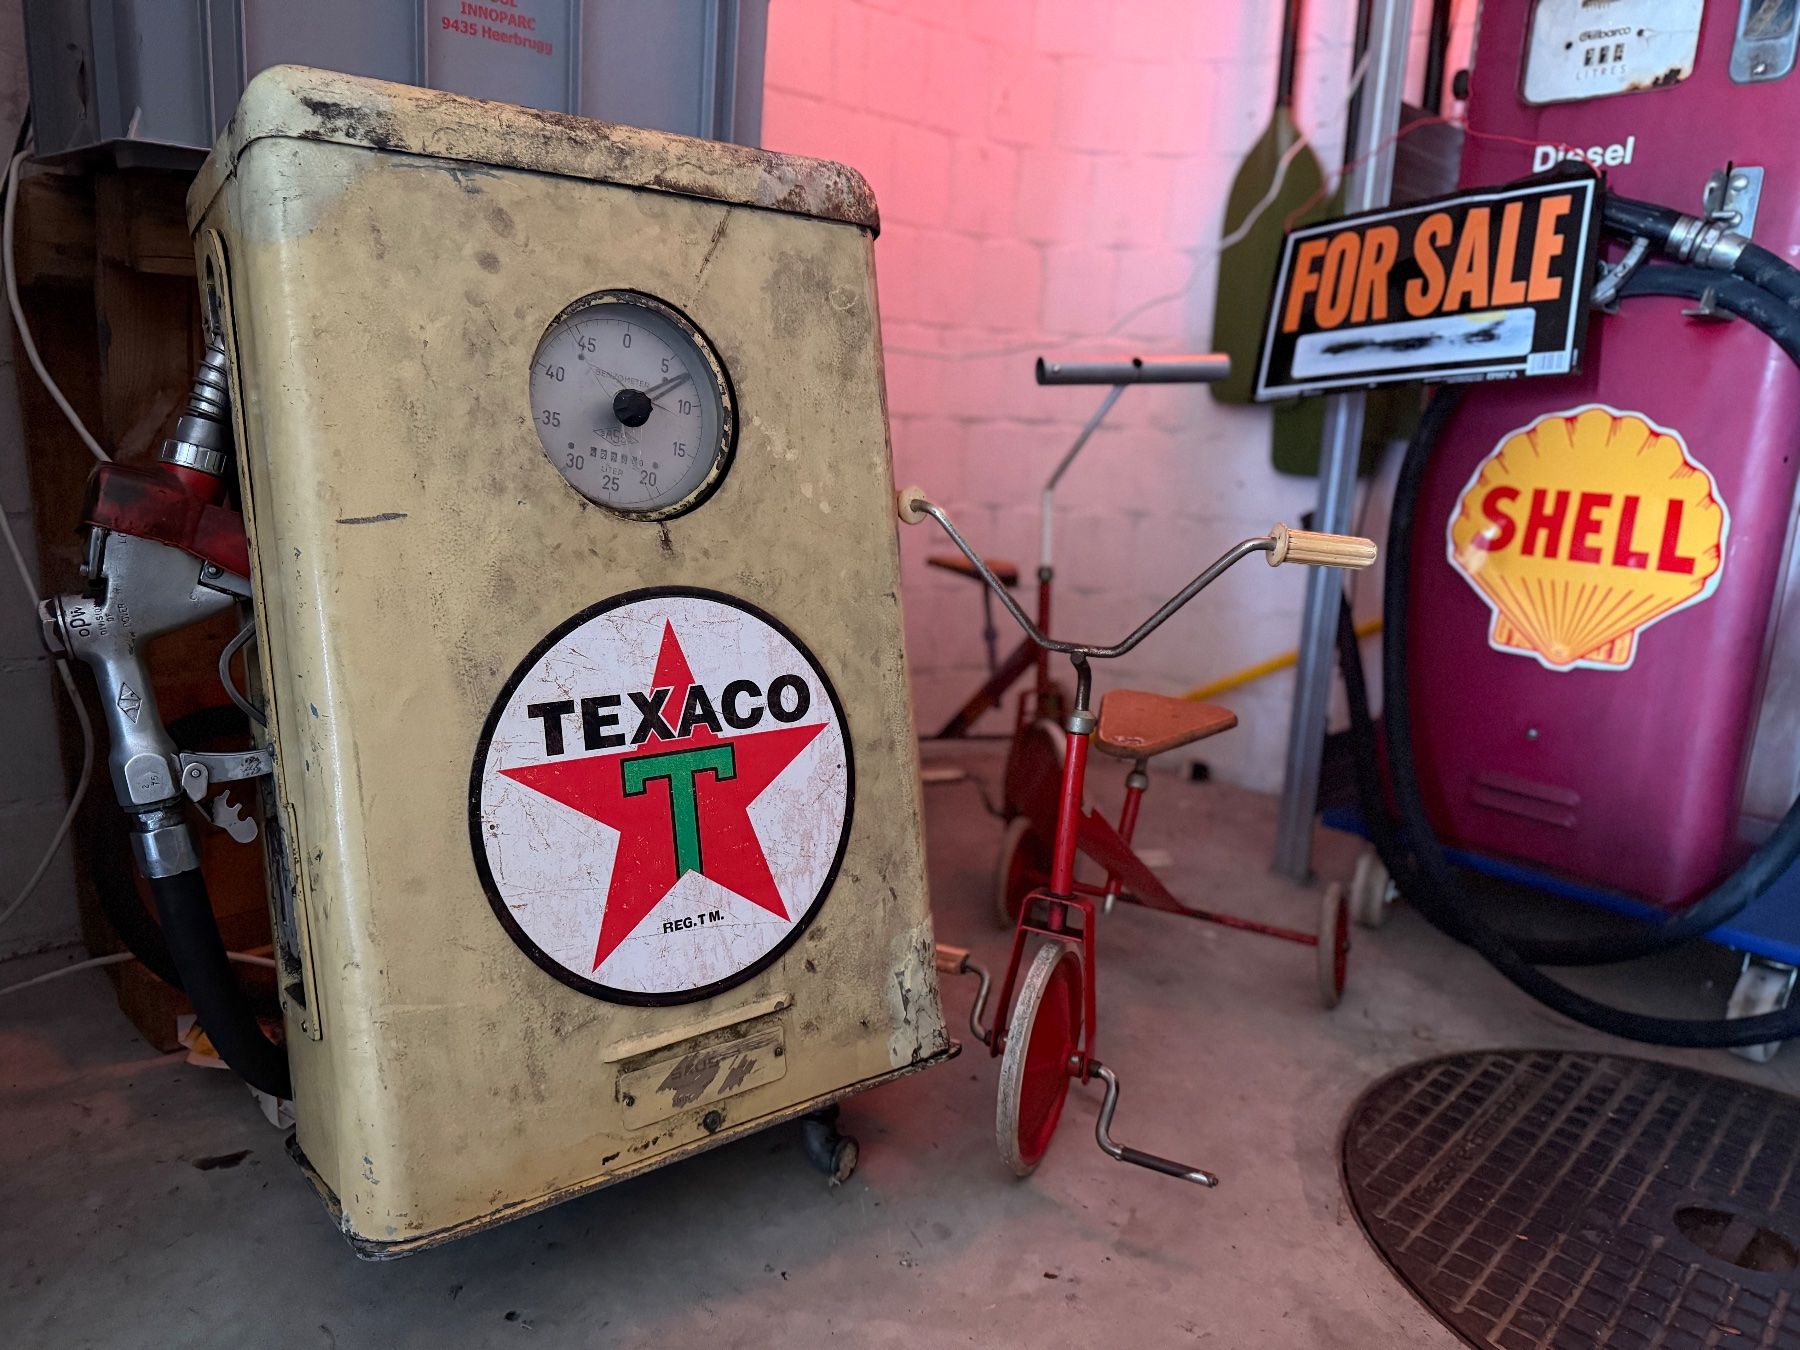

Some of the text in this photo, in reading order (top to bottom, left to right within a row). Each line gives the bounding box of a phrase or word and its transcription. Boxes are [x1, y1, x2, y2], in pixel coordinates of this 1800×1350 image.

[460, 1, 536, 31] INNOPARC
[441, 16, 553, 55] 9435 Heerbrugg
[1576, 64, 1627, 80] LITRES
[1283, 194, 1573, 333] FOR SALE
[578, 335, 596, 352] 45
[622, 333, 632, 349] 0
[660, 357, 669, 373] 5
[545, 366, 565, 382] 40
[677, 399, 692, 415] 10
[542, 410, 561, 427] 35
[672, 441, 686, 458] 15
[565, 453, 584, 470] 30
[602, 475, 620, 492] 25
[639, 470, 657, 487] 20
[1472, 485, 1696, 575] SHELL
[527, 674, 811, 757] TEXACO
